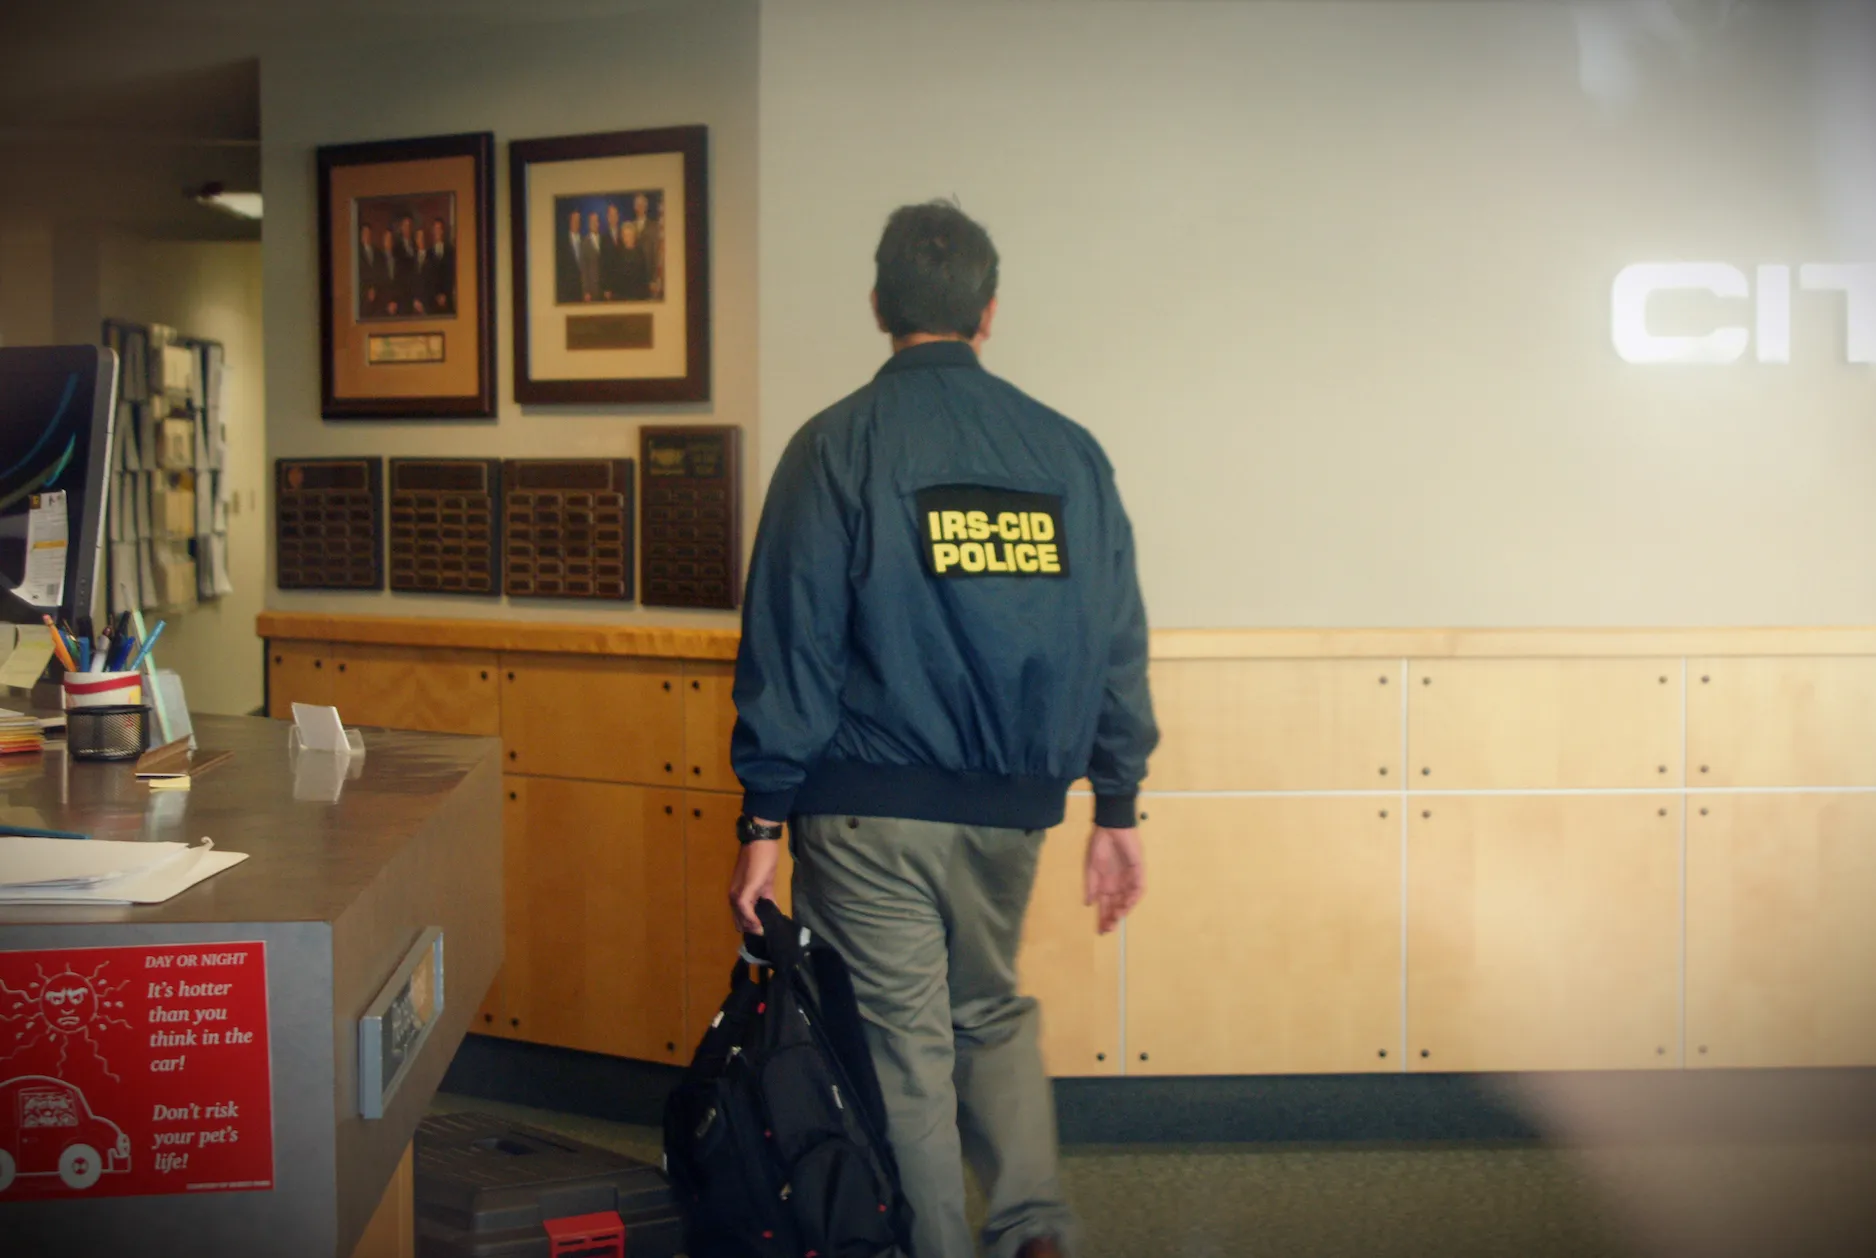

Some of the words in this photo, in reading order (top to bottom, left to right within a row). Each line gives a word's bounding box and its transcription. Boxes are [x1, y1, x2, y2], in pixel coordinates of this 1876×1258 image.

[1611, 262, 1876, 364] CIT
[928, 510, 1055, 541] IRS-CID
[932, 542, 1061, 573] POLICE
[145, 955, 174, 968] DAY
[176, 954, 198, 967] OR
[201, 952, 248, 966] NIGHT
[147, 981, 174, 998] It's
[178, 980, 232, 997] hotter
[149, 1006, 189, 1022] than
[192, 1008, 227, 1025] you
[150, 1029, 197, 1047] think
[202, 1029, 220, 1045] in
[224, 1027, 253, 1044] the
[150, 1055, 185, 1072] car!
[152, 1103, 201, 1121] Don't
[205, 1101, 238, 1118] risk
[151, 1132, 195, 1150] your
[198, 1126, 239, 1148] pet's
[154, 1152, 189, 1173] life!
